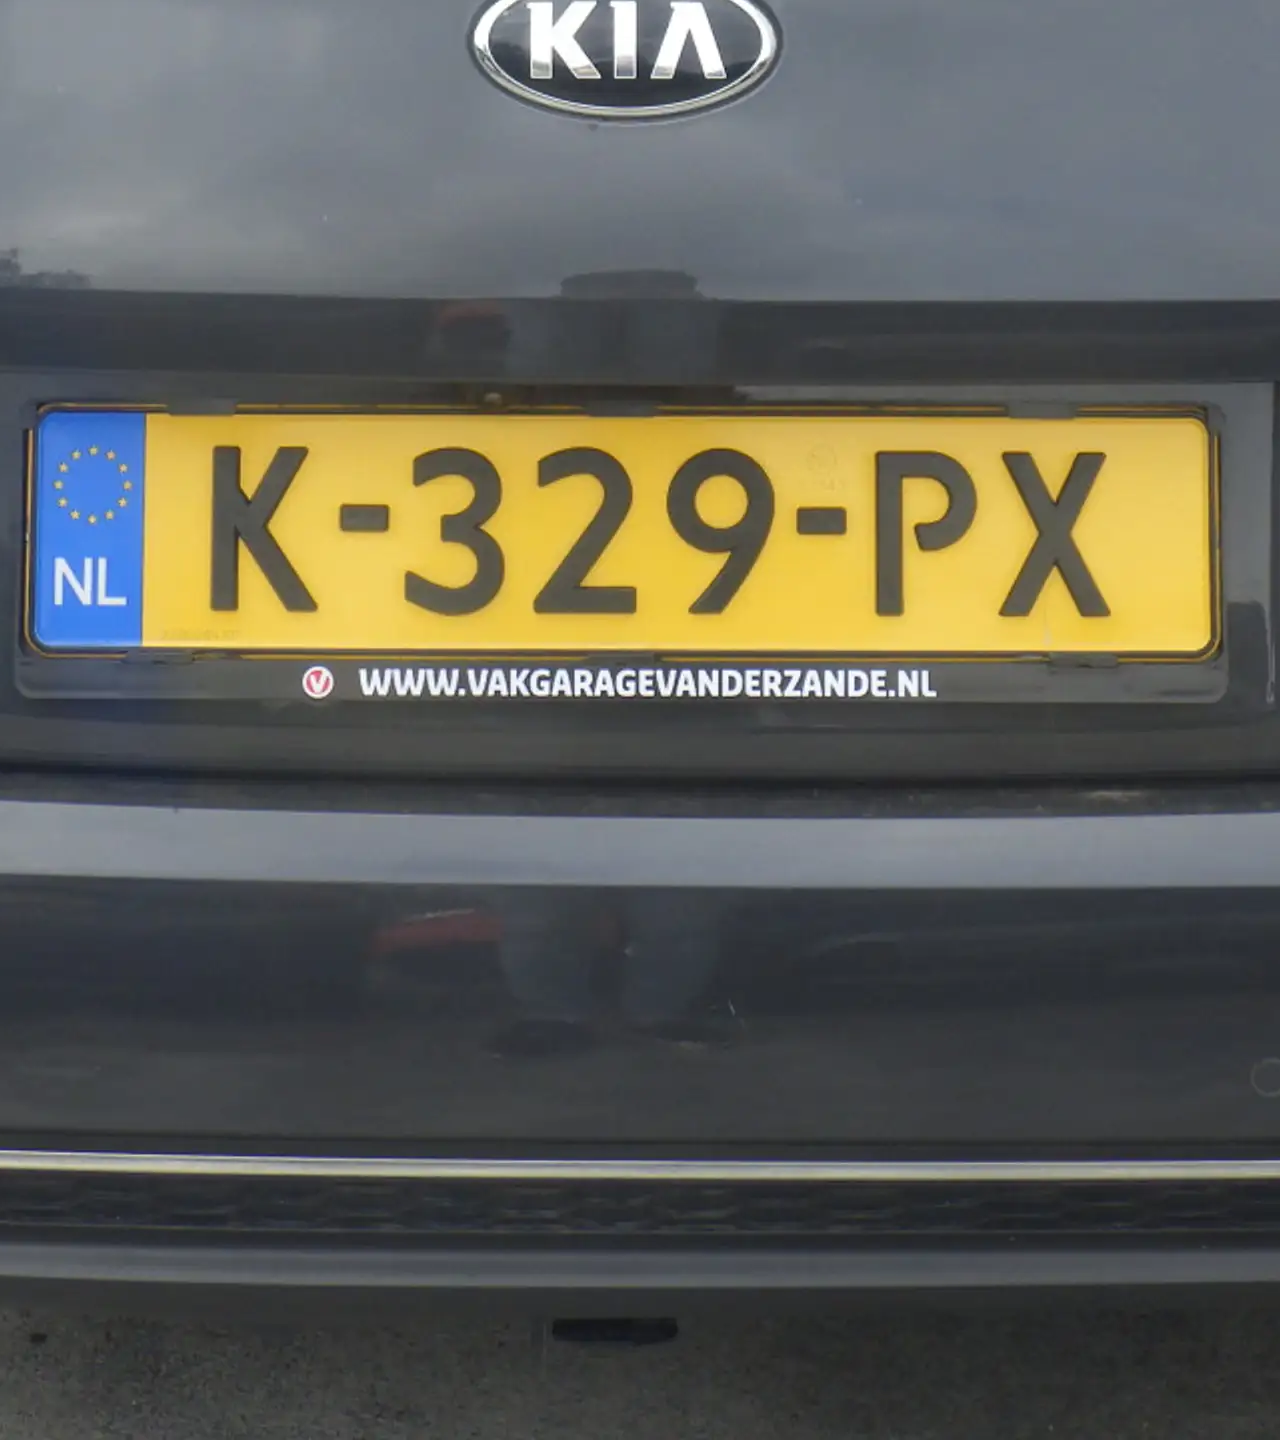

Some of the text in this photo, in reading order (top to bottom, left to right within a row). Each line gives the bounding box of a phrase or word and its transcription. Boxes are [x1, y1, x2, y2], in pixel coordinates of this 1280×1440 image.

[526, 0, 727, 79] KIA
[210, 445, 1113, 618] K-329-PX
[53, 557, 127, 606] NL
[358, 667, 938, 699] WWW.VAKGARAGEVANDERZANDE.NL
